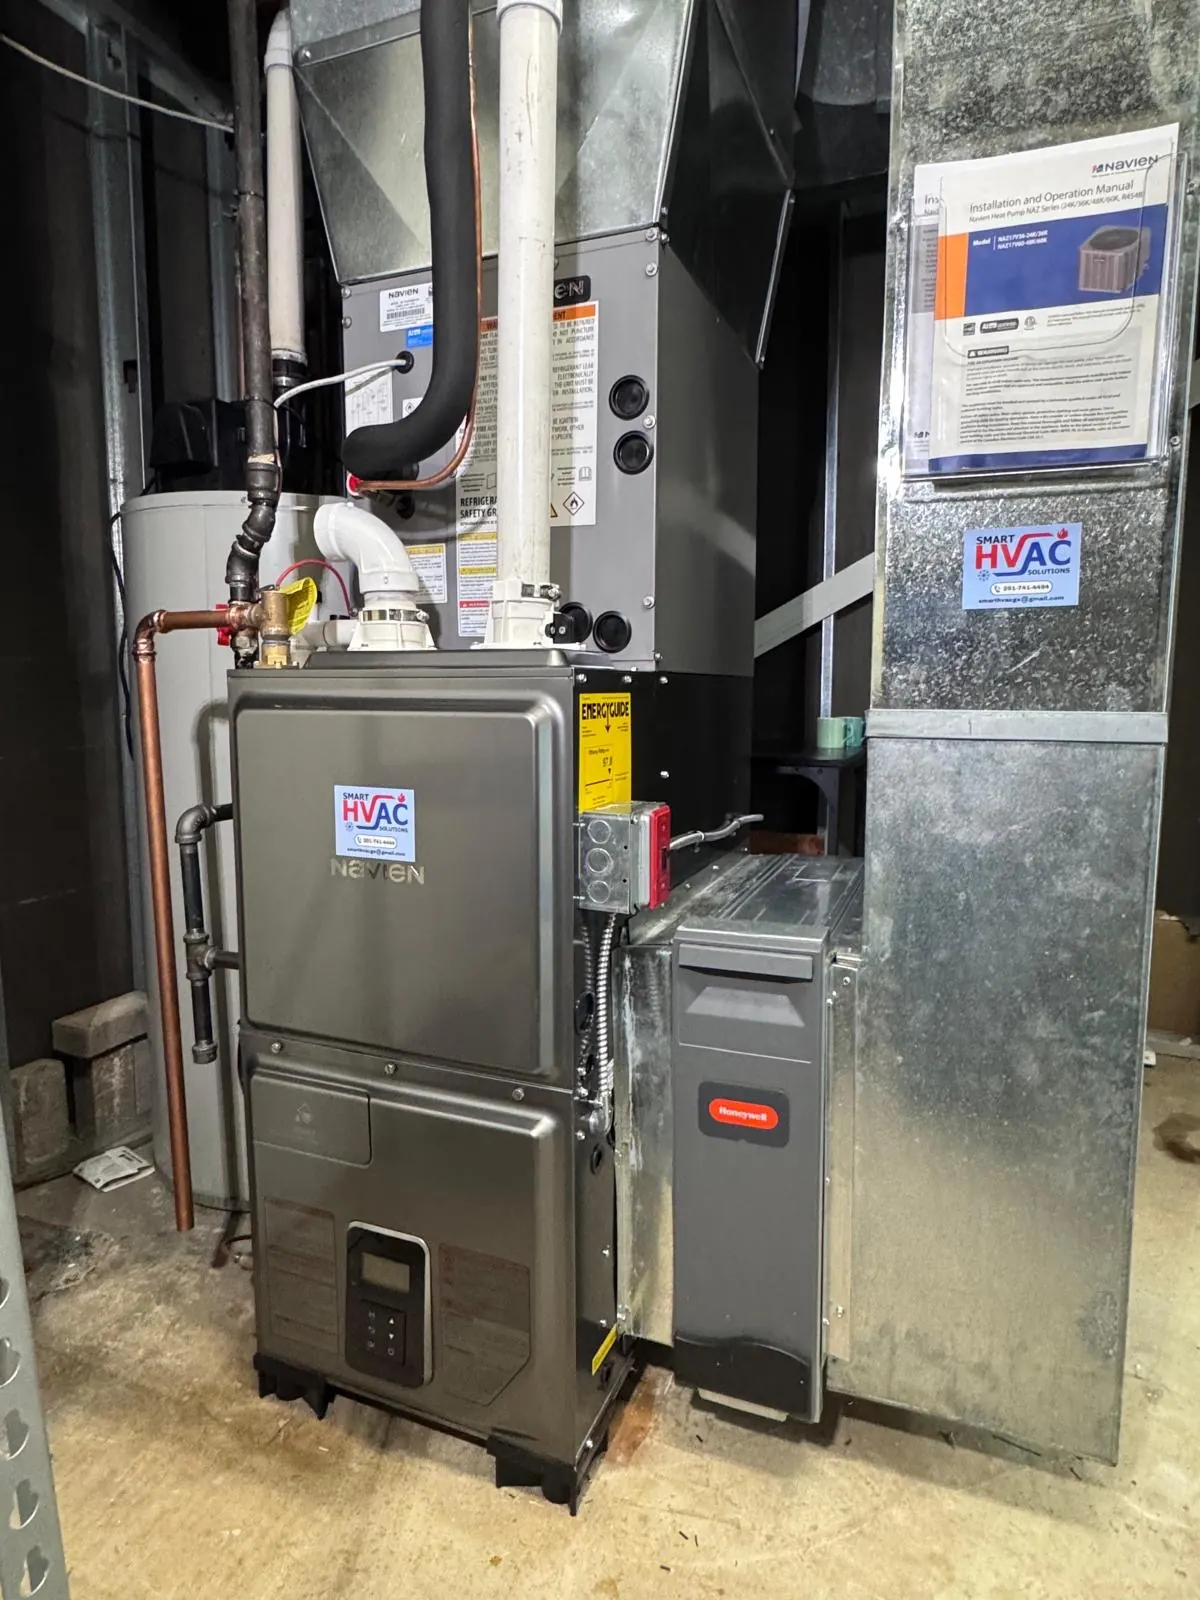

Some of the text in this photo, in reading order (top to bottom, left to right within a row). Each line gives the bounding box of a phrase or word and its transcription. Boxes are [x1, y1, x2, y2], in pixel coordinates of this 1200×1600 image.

[970, 179, 1134, 213] Installation and Operation Manual
[1007, 209, 1025, 218] Pump
[972, 237, 991, 247] Model
[460, 508, 486, 519] SAFETY
[976, 534, 1016, 545] SMART
[975, 534, 1072, 573] HVAC
[1027, 567, 1070, 576] SOLUTIONS
[582, 701, 629, 720] ENERGYGUIDE
[343, 792, 370, 801] SMART
[343, 797, 408, 828] HVAC
[379, 826, 409, 834] SOLUTIONS
[719, 1105, 768, 1121] Honeywell
